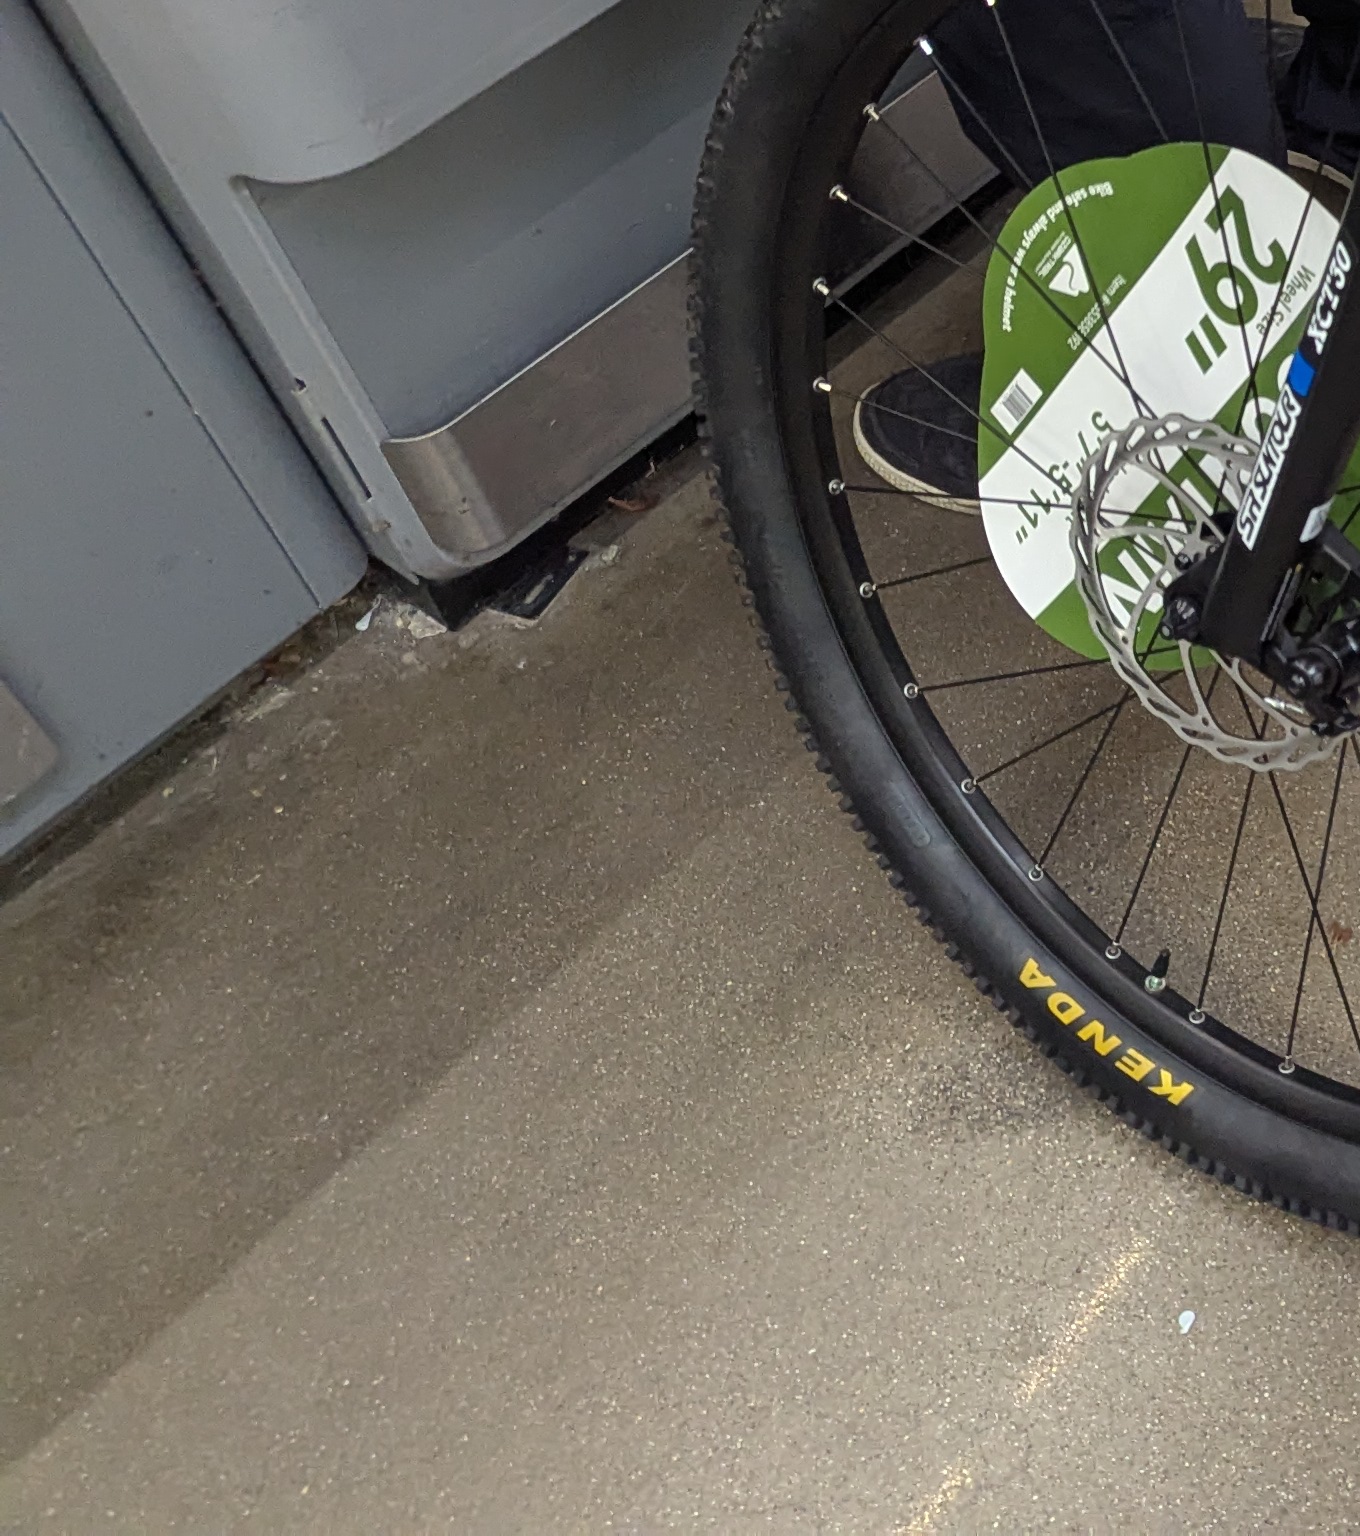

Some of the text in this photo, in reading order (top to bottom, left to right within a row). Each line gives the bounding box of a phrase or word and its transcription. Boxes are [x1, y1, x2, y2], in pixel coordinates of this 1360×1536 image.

[1065, 187, 1088, 208] safe
[1088, 181, 1114, 197] Bike
[1021, 214, 1049, 250] always
[1007, 276, 1016, 288] a
[1279, 264, 1316, 317] Wheel
[1002, 286, 1017, 333] helmet
[1250, 382, 1301, 506] SUNTOUR
[1019, 958, 1195, 1106] KENDA
